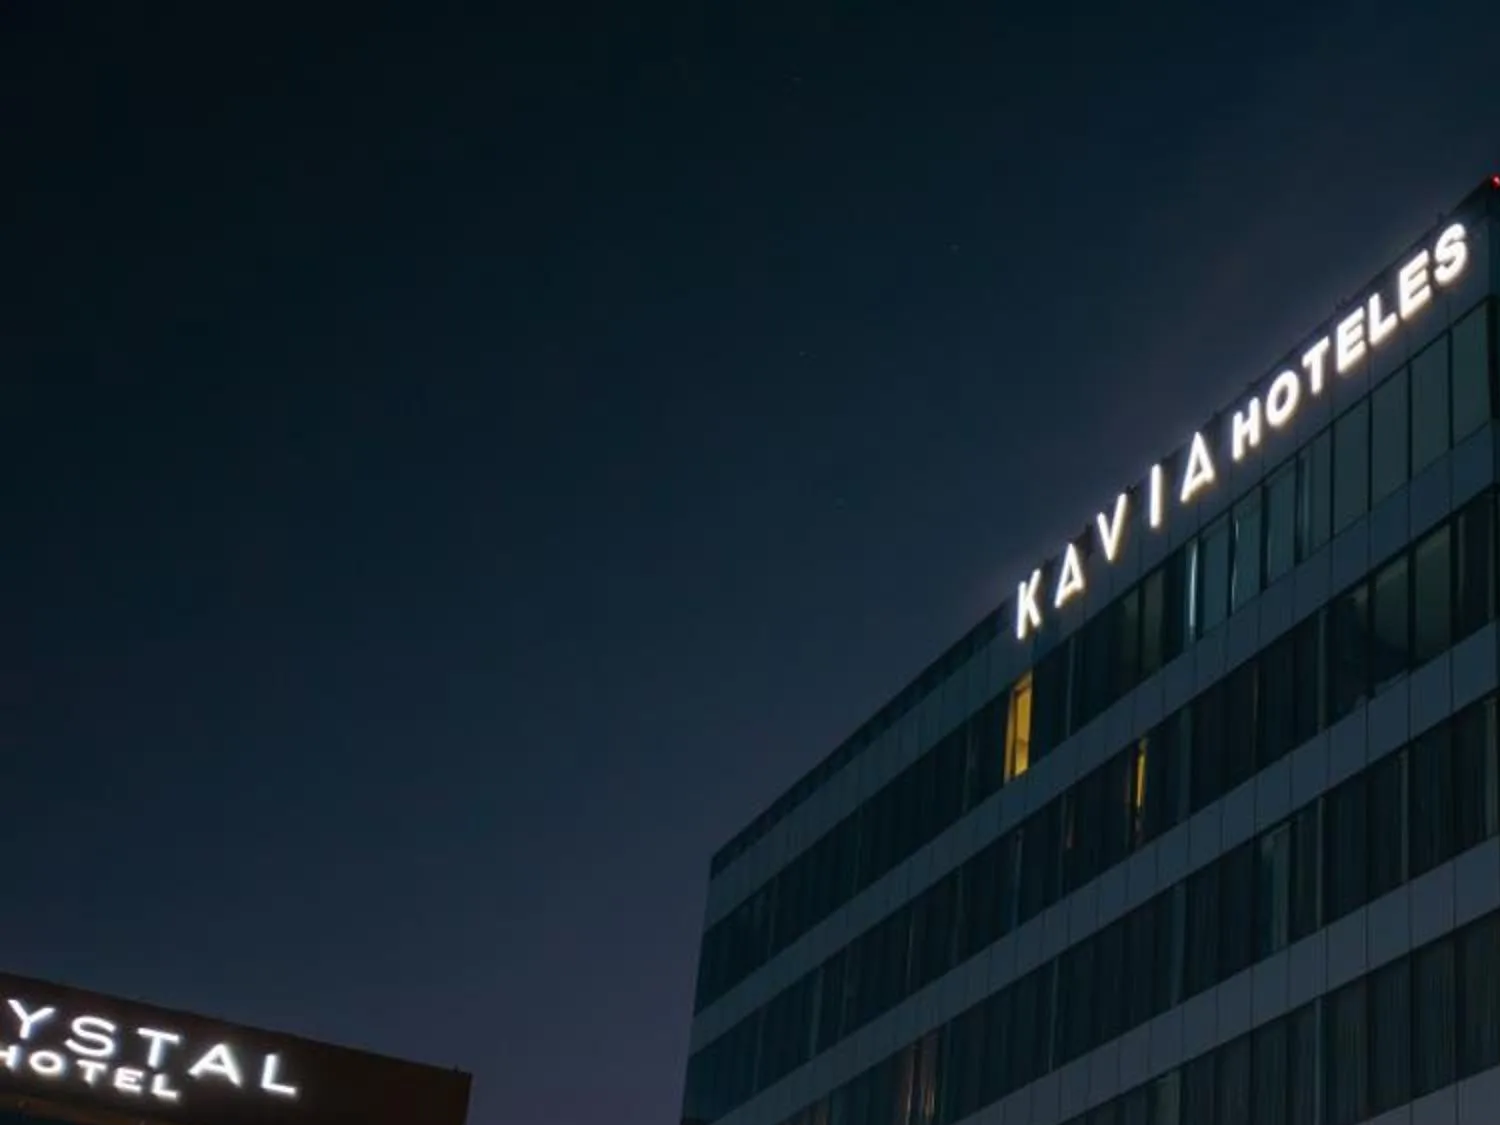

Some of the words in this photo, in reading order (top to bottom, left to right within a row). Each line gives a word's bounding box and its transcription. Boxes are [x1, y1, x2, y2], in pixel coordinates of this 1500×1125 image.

[1016, 431, 1216, 640] KAVIA
[1230, 222, 1469, 462] HOTELES
[7, 998, 297, 1097] YSTAL
